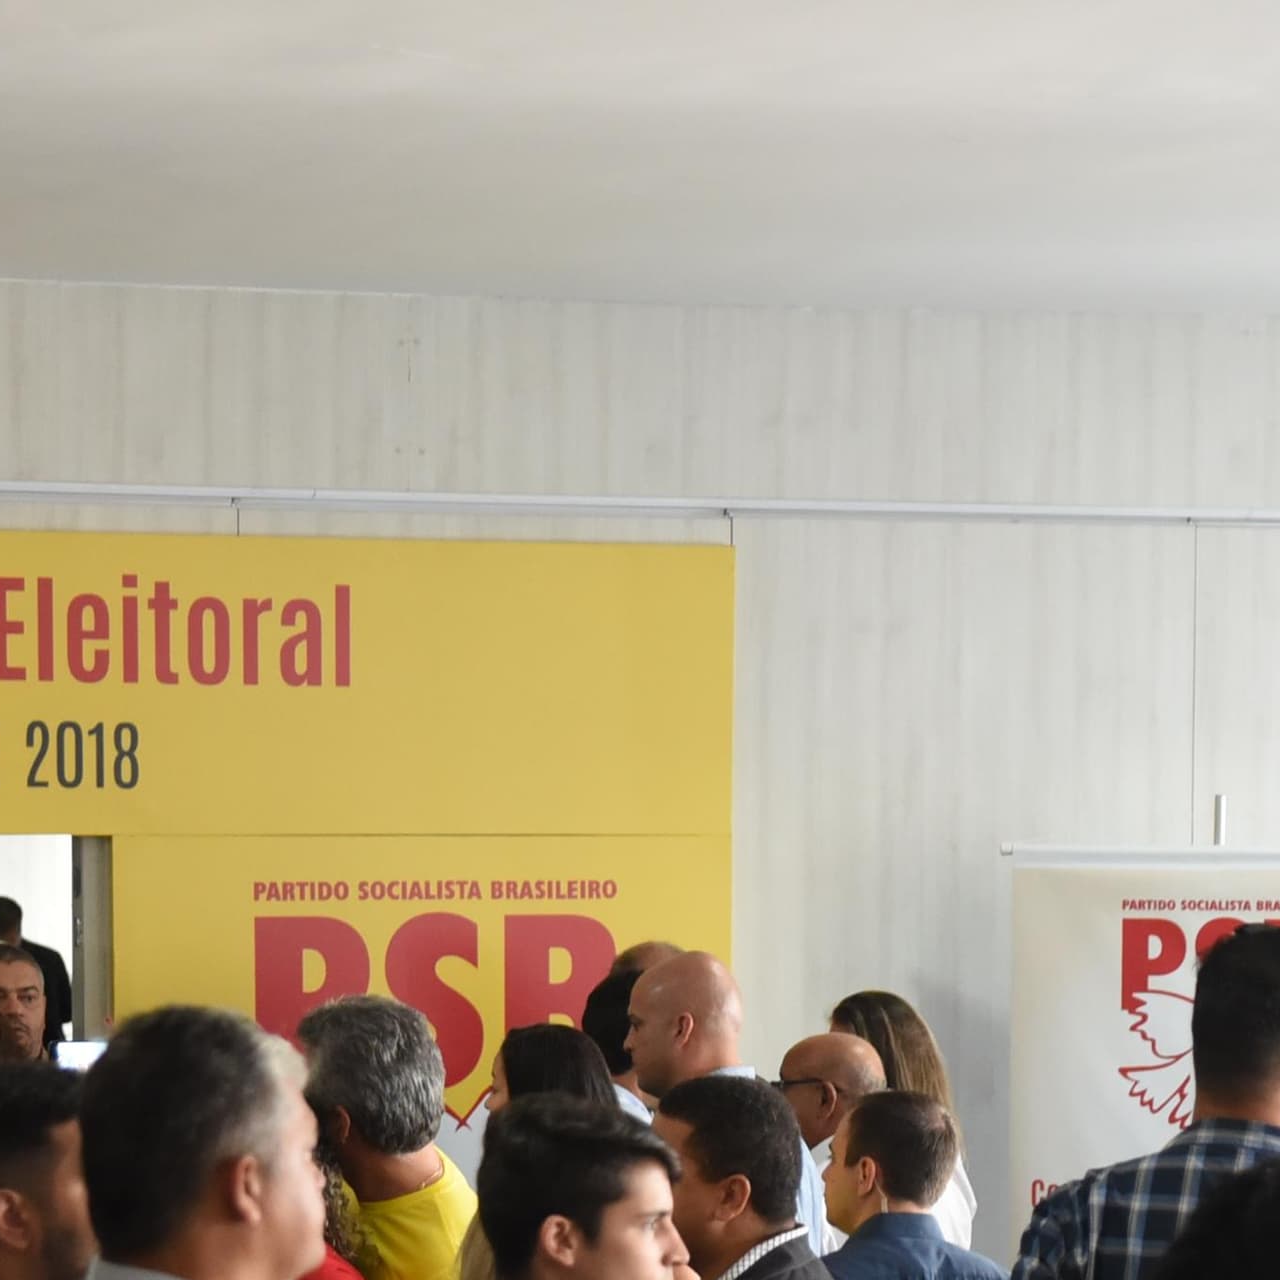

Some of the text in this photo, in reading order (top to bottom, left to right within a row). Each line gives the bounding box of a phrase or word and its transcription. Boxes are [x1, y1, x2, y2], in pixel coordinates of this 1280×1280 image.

[26, 720, 140, 790] 2018
[253, 879, 618, 902] PARTIDO SOCIALISTA BRASILEIRO
[1121, 899, 1176, 911] PARTIDO
[1181, 899, 1252, 912] SOCIALISTA
